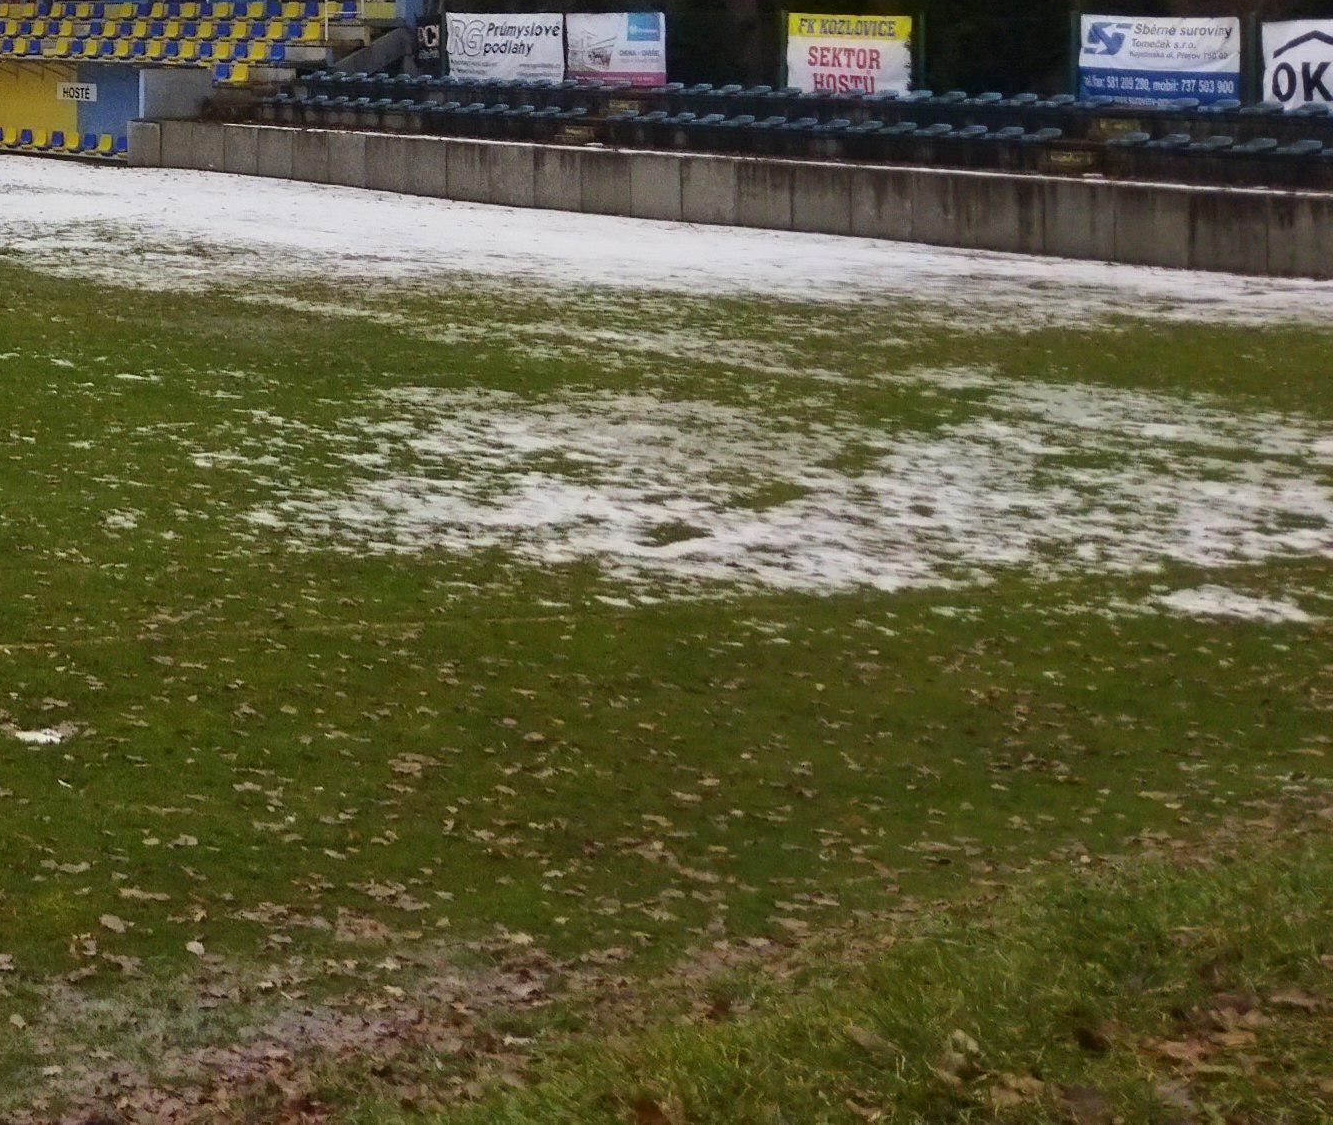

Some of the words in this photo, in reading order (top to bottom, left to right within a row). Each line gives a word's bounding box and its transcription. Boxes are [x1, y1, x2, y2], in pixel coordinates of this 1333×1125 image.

[799, 18, 816, 33] FK
[819, 19, 897, 37] KOZLOVICE
[1179, 25, 1233, 39] suroviny
[483, 40, 534, 57] podlahy
[808, 45, 881, 69] SEKTOR
[63, 85, 90, 100] HOSTÉ
[1181, 79, 1196, 93] 737
